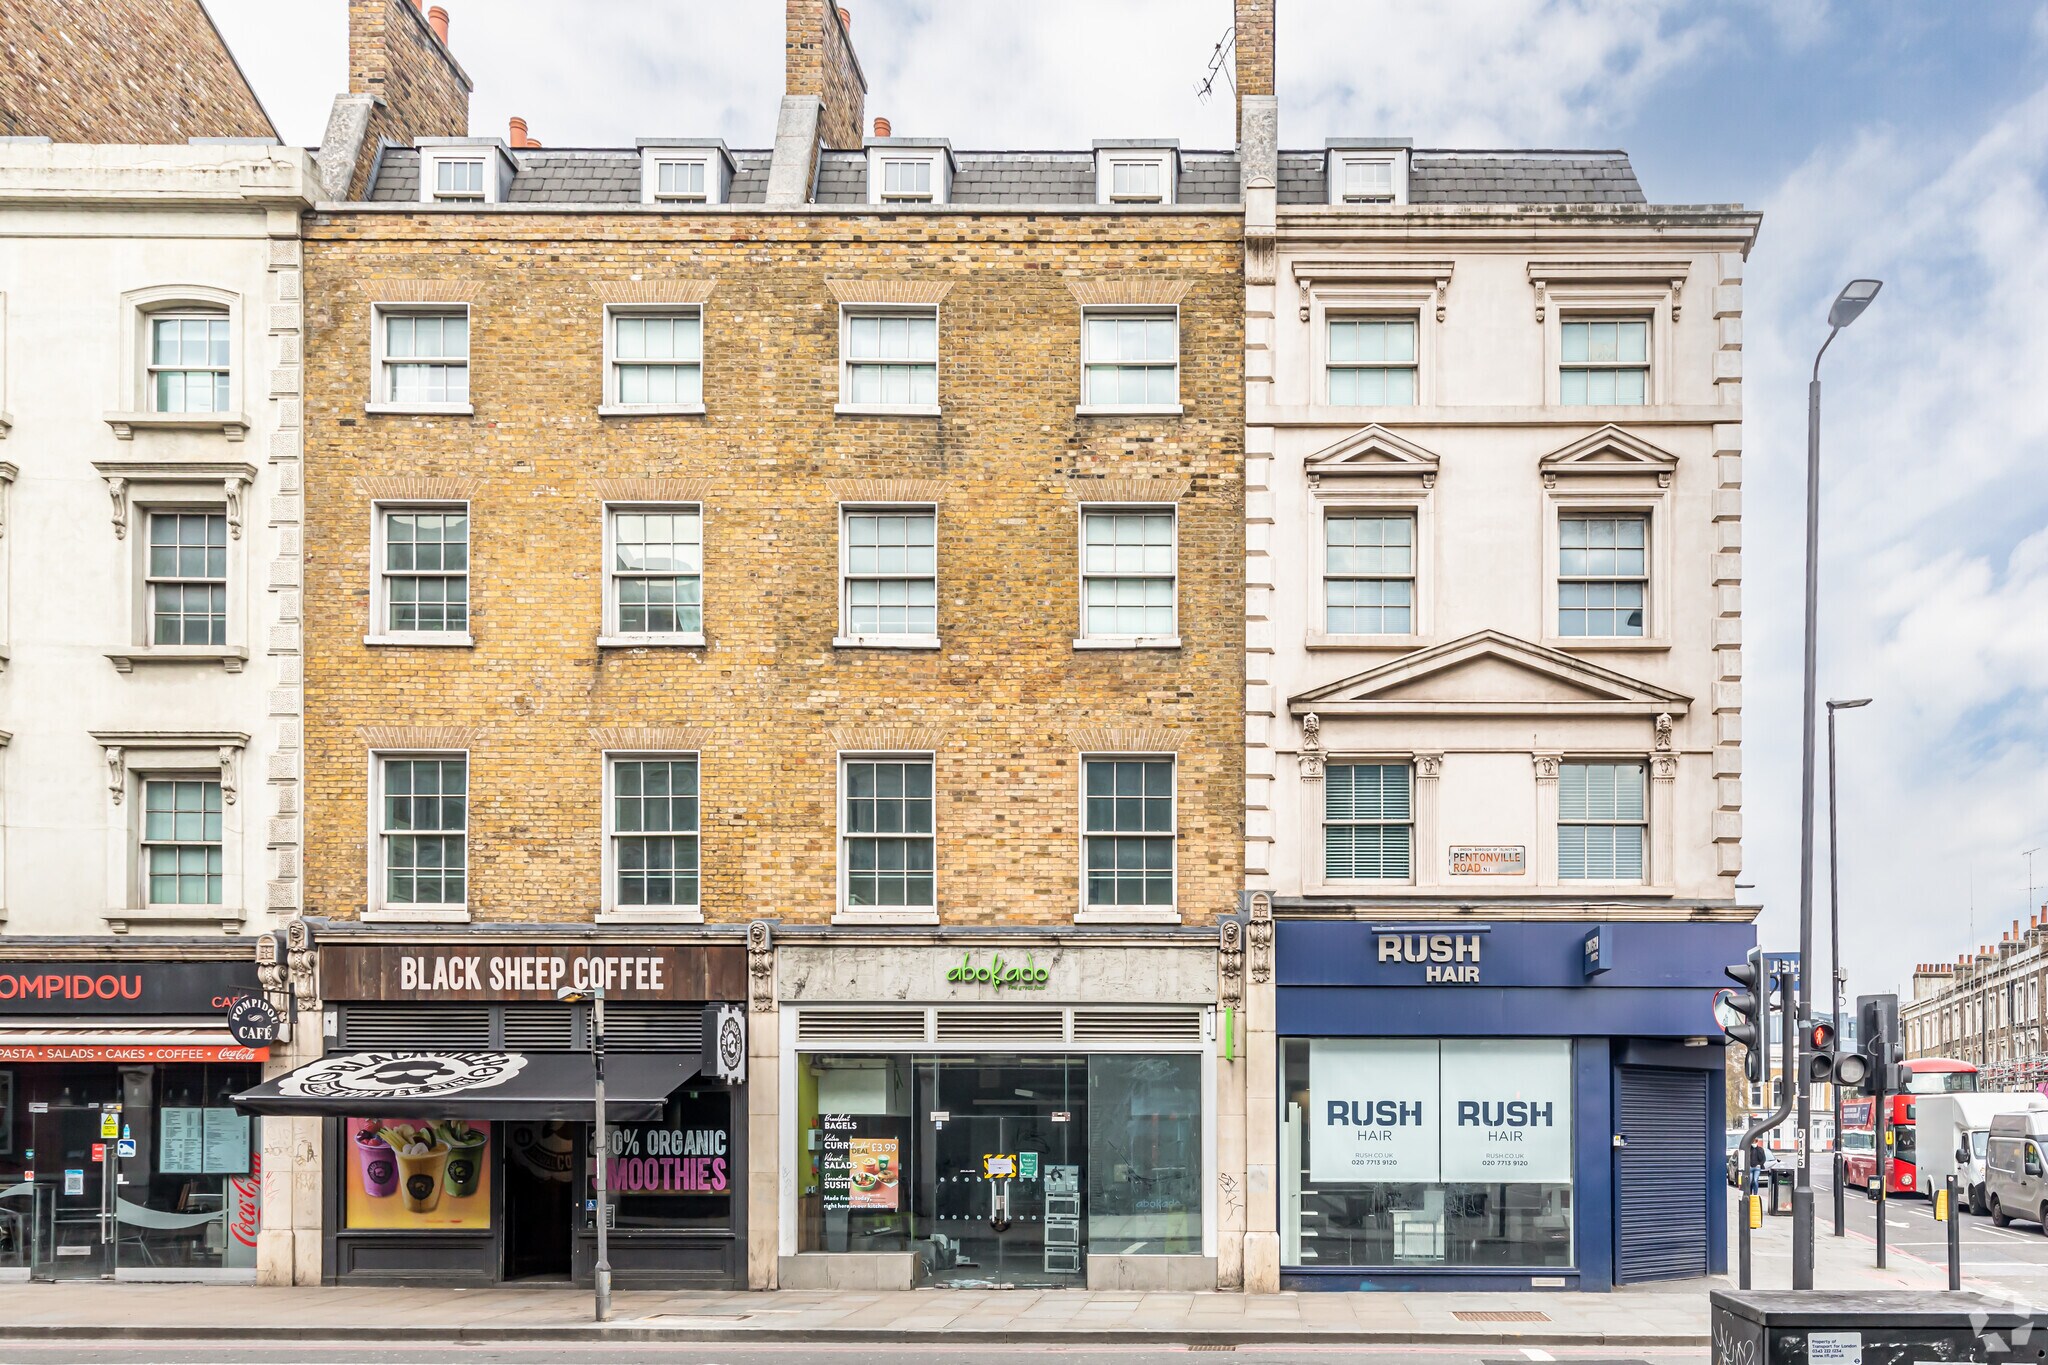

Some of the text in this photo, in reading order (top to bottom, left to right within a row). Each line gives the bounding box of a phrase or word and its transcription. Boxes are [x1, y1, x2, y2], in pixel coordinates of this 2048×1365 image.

[1453, 852, 1521, 862] PENTONVILLE
[1453, 863, 1481, 872] ROAD
[1378, 935, 1480, 963] RUSH
[401, 956, 664, 991] BLACK SHEEP COFFEE
[946, 951, 1049, 992] abokado
[1426, 966, 1480, 983] HAIR
[232, 999, 279, 1024] POMPIDOU
[239, 1025, 273, 1040] CAFÉ
[47, 1049, 94, 1059] SALADS
[105, 1049, 145, 1059] CAKES
[156, 1049, 203, 1059] COFFEE
[1327, 1100, 1422, 1126] RUSH
[1458, 1101, 1553, 1127] RUSH
[647, 1130, 726, 1156] ORGANIC
[1357, 1130, 1392, 1141] HAIR
[1488, 1131, 1523, 1141] HAIR
[871, 1143, 897, 1152] £3.99
[824, 1161, 857, 1169] SALADS
[824, 1181, 850, 1189] SUSHI
